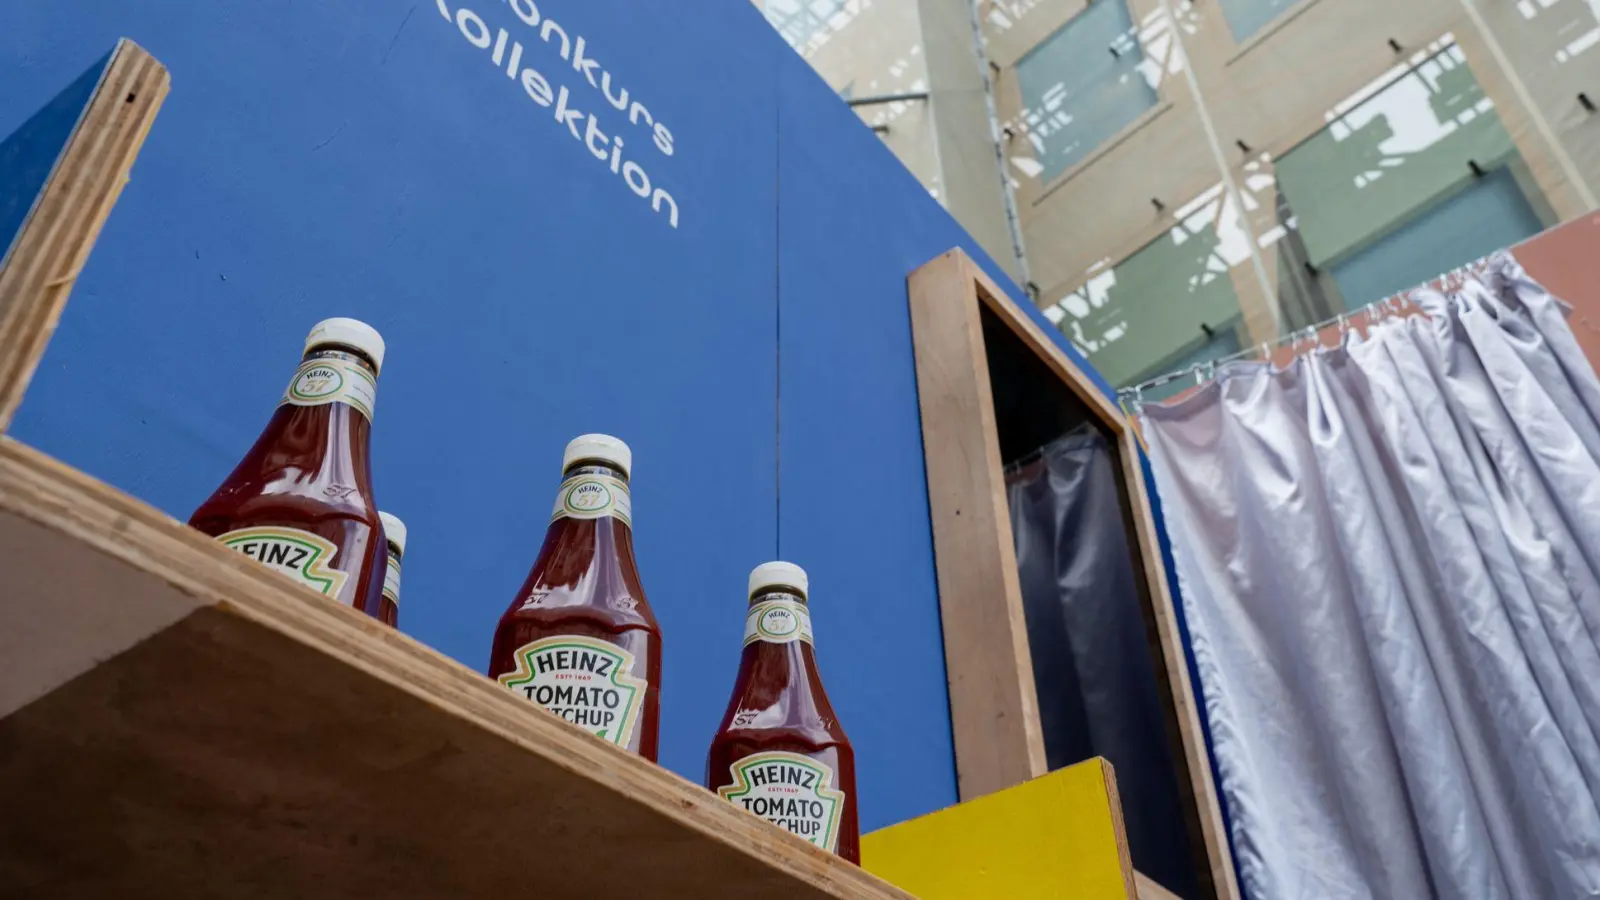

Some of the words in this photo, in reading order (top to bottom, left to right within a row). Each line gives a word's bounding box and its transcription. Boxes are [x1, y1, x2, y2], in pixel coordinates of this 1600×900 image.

[503, 0, 674, 156] onkurs
[306, 370, 334, 379] HEINZ
[301, 380, 330, 392] 57
[578, 485, 603, 494] HEINZ
[575, 494, 600, 506] 57
[231, 543, 309, 569] EINZ
[768, 611, 790, 619] HEINZ
[537, 651, 613, 677] HEINZ
[523, 685, 620, 709] TOMATO
[545, 707, 615, 727] TCHUP
[750, 765, 816, 790] HEINZ
[742, 798, 824, 819] TOMATO
